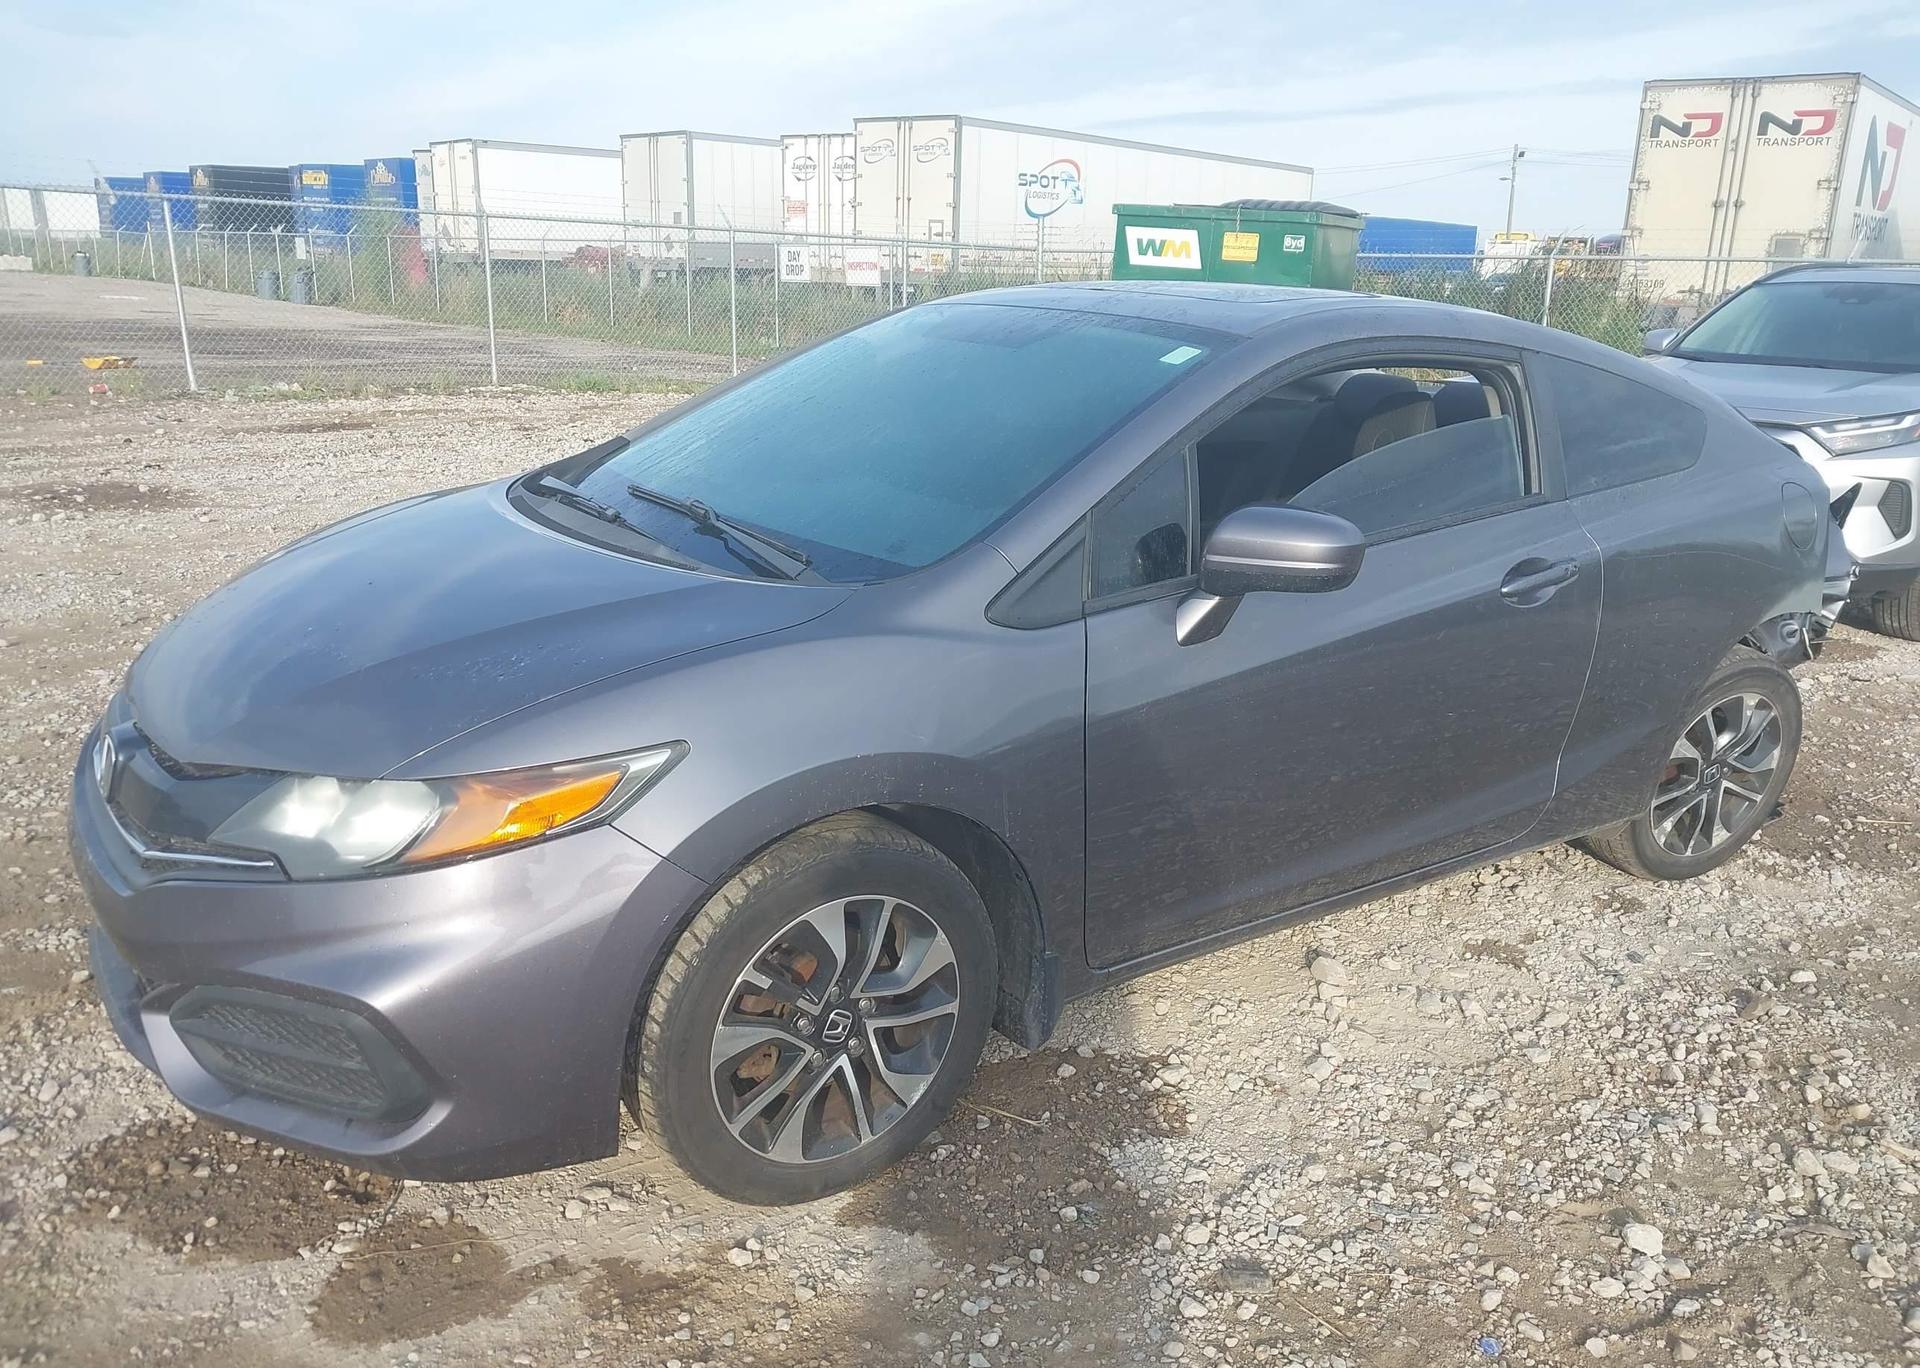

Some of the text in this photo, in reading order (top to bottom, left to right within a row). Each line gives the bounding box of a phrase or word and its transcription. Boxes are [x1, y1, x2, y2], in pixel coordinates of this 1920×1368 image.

[1649, 138, 1720, 149] TRANSPORT
[1756, 136, 1832, 147] TRANSPORT
[1136, 238, 1192, 259] WM
[787, 250, 801, 262] DAY
[786, 264, 805, 276] DROP
[847, 261, 878, 272] INSPECTION
